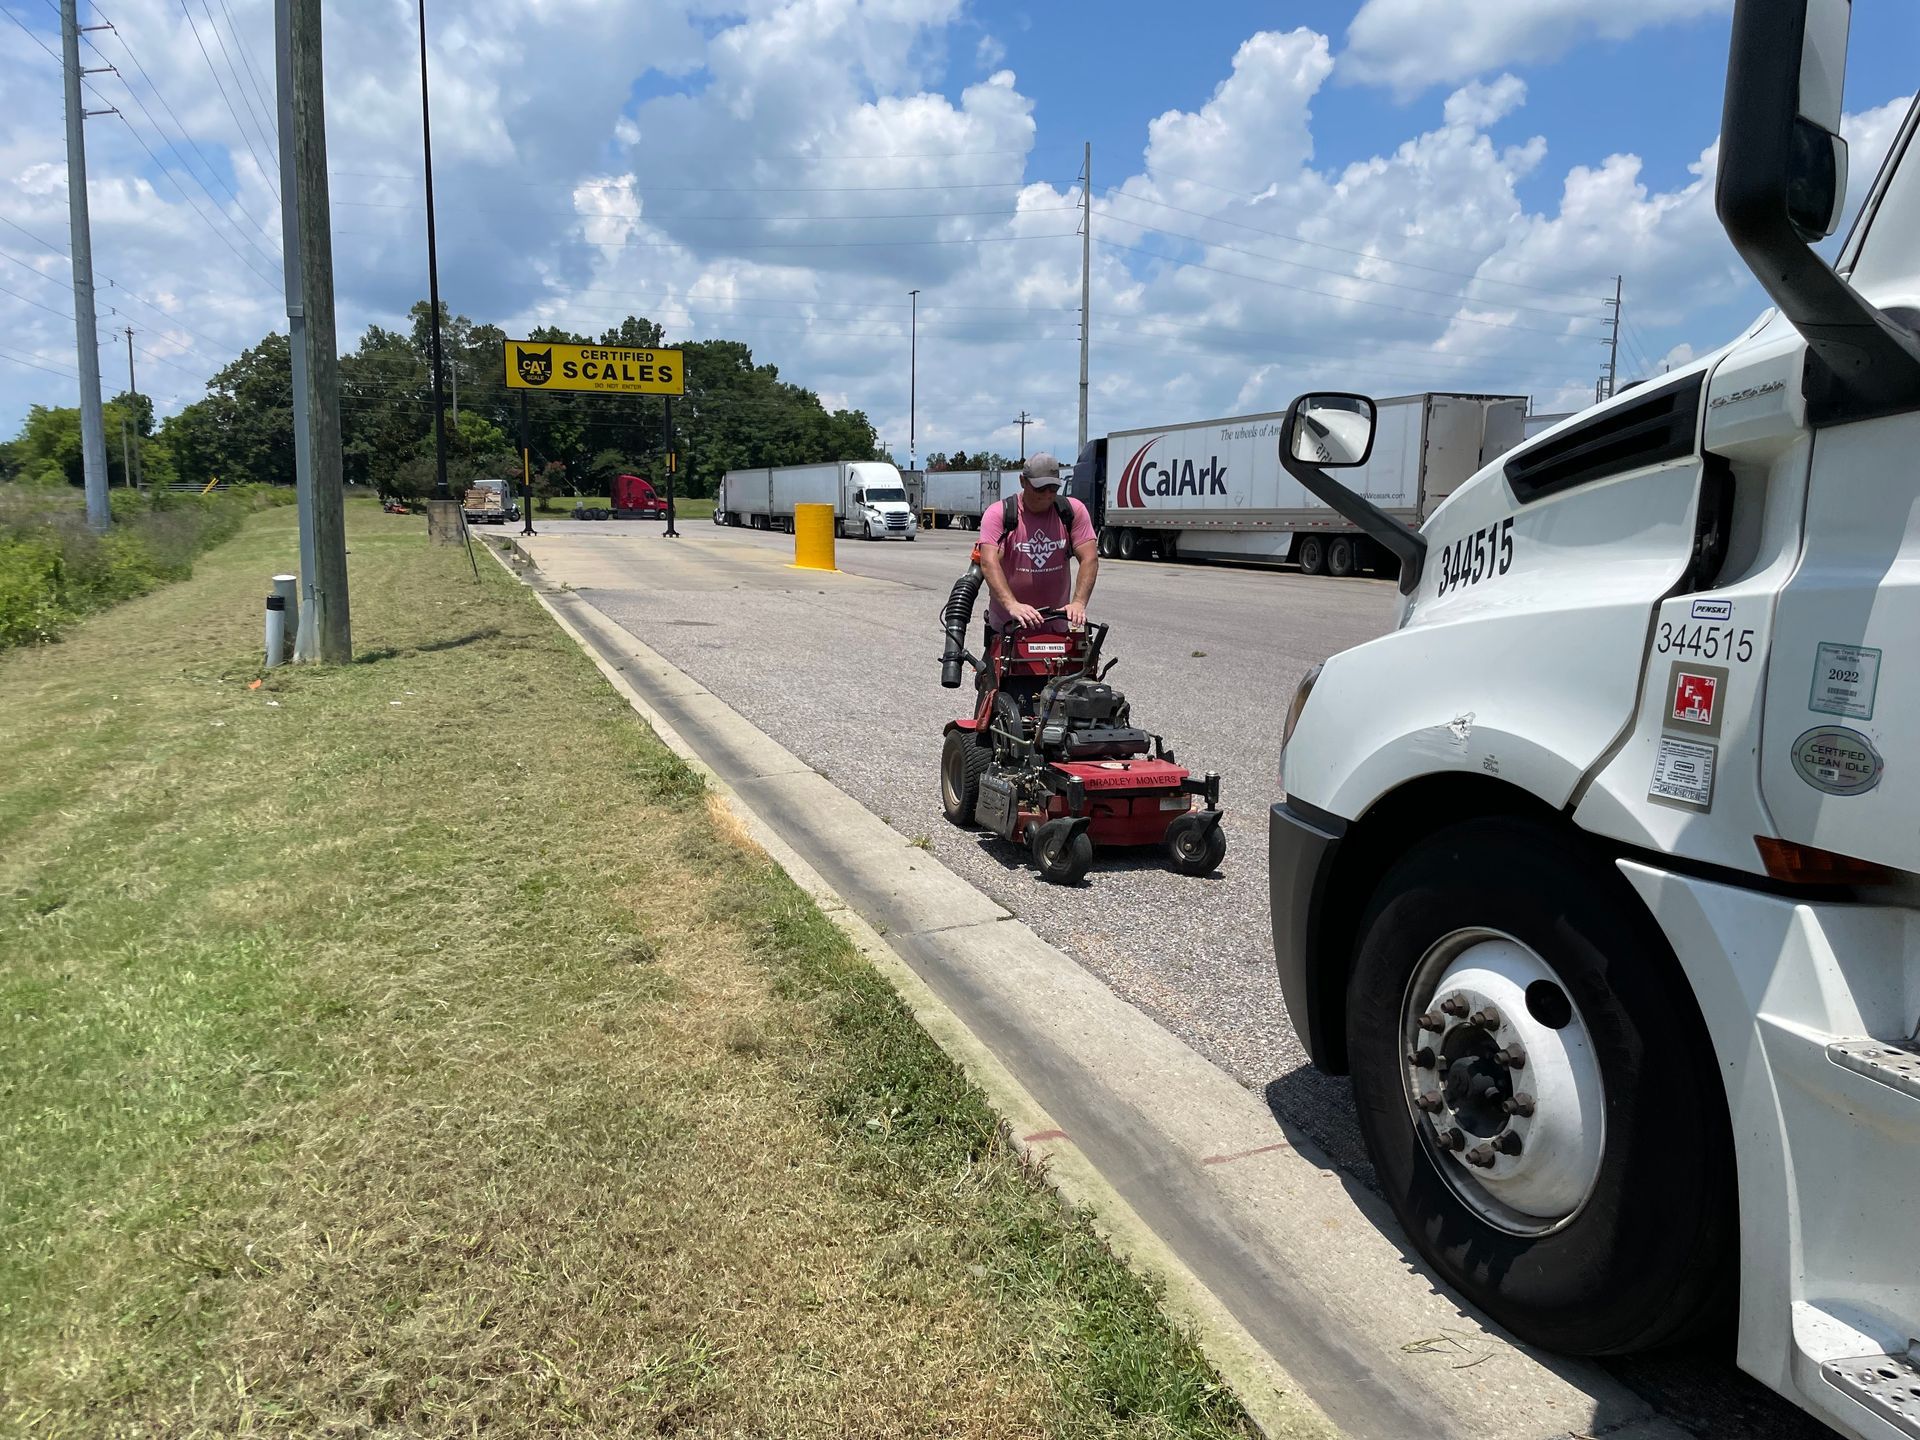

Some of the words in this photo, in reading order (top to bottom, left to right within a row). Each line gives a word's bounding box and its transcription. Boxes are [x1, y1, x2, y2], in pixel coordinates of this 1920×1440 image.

[580, 349, 654, 362] CERTIFIED
[522, 360, 547, 375] CAT
[562, 361, 673, 383] SCALES
[1220, 428, 1233, 441] The
[1235, 425, 1258, 440] wheels
[1260, 424, 1269, 437] of
[1141, 456, 1228, 497] CalArk
[1014, 539, 1066, 552] KEYMOW
[1438, 516, 1514, 598] 344515
[1695, 605, 1728, 614] PENSKE
[1657, 622, 1754, 663] 344515
[1705, 679, 1714, 687] 24
[1828, 668, 1859, 683] 2022
[1675, 710, 1685, 718] CA
[1810, 744, 1866, 762] CERTIFIED
[1804, 754, 1840, 769] CLEAN
[1845, 762, 1870, 774] IDLE
[1089, 777, 1131, 787] BRADLEY
[1136, 775, 1177, 785] MOWERS
